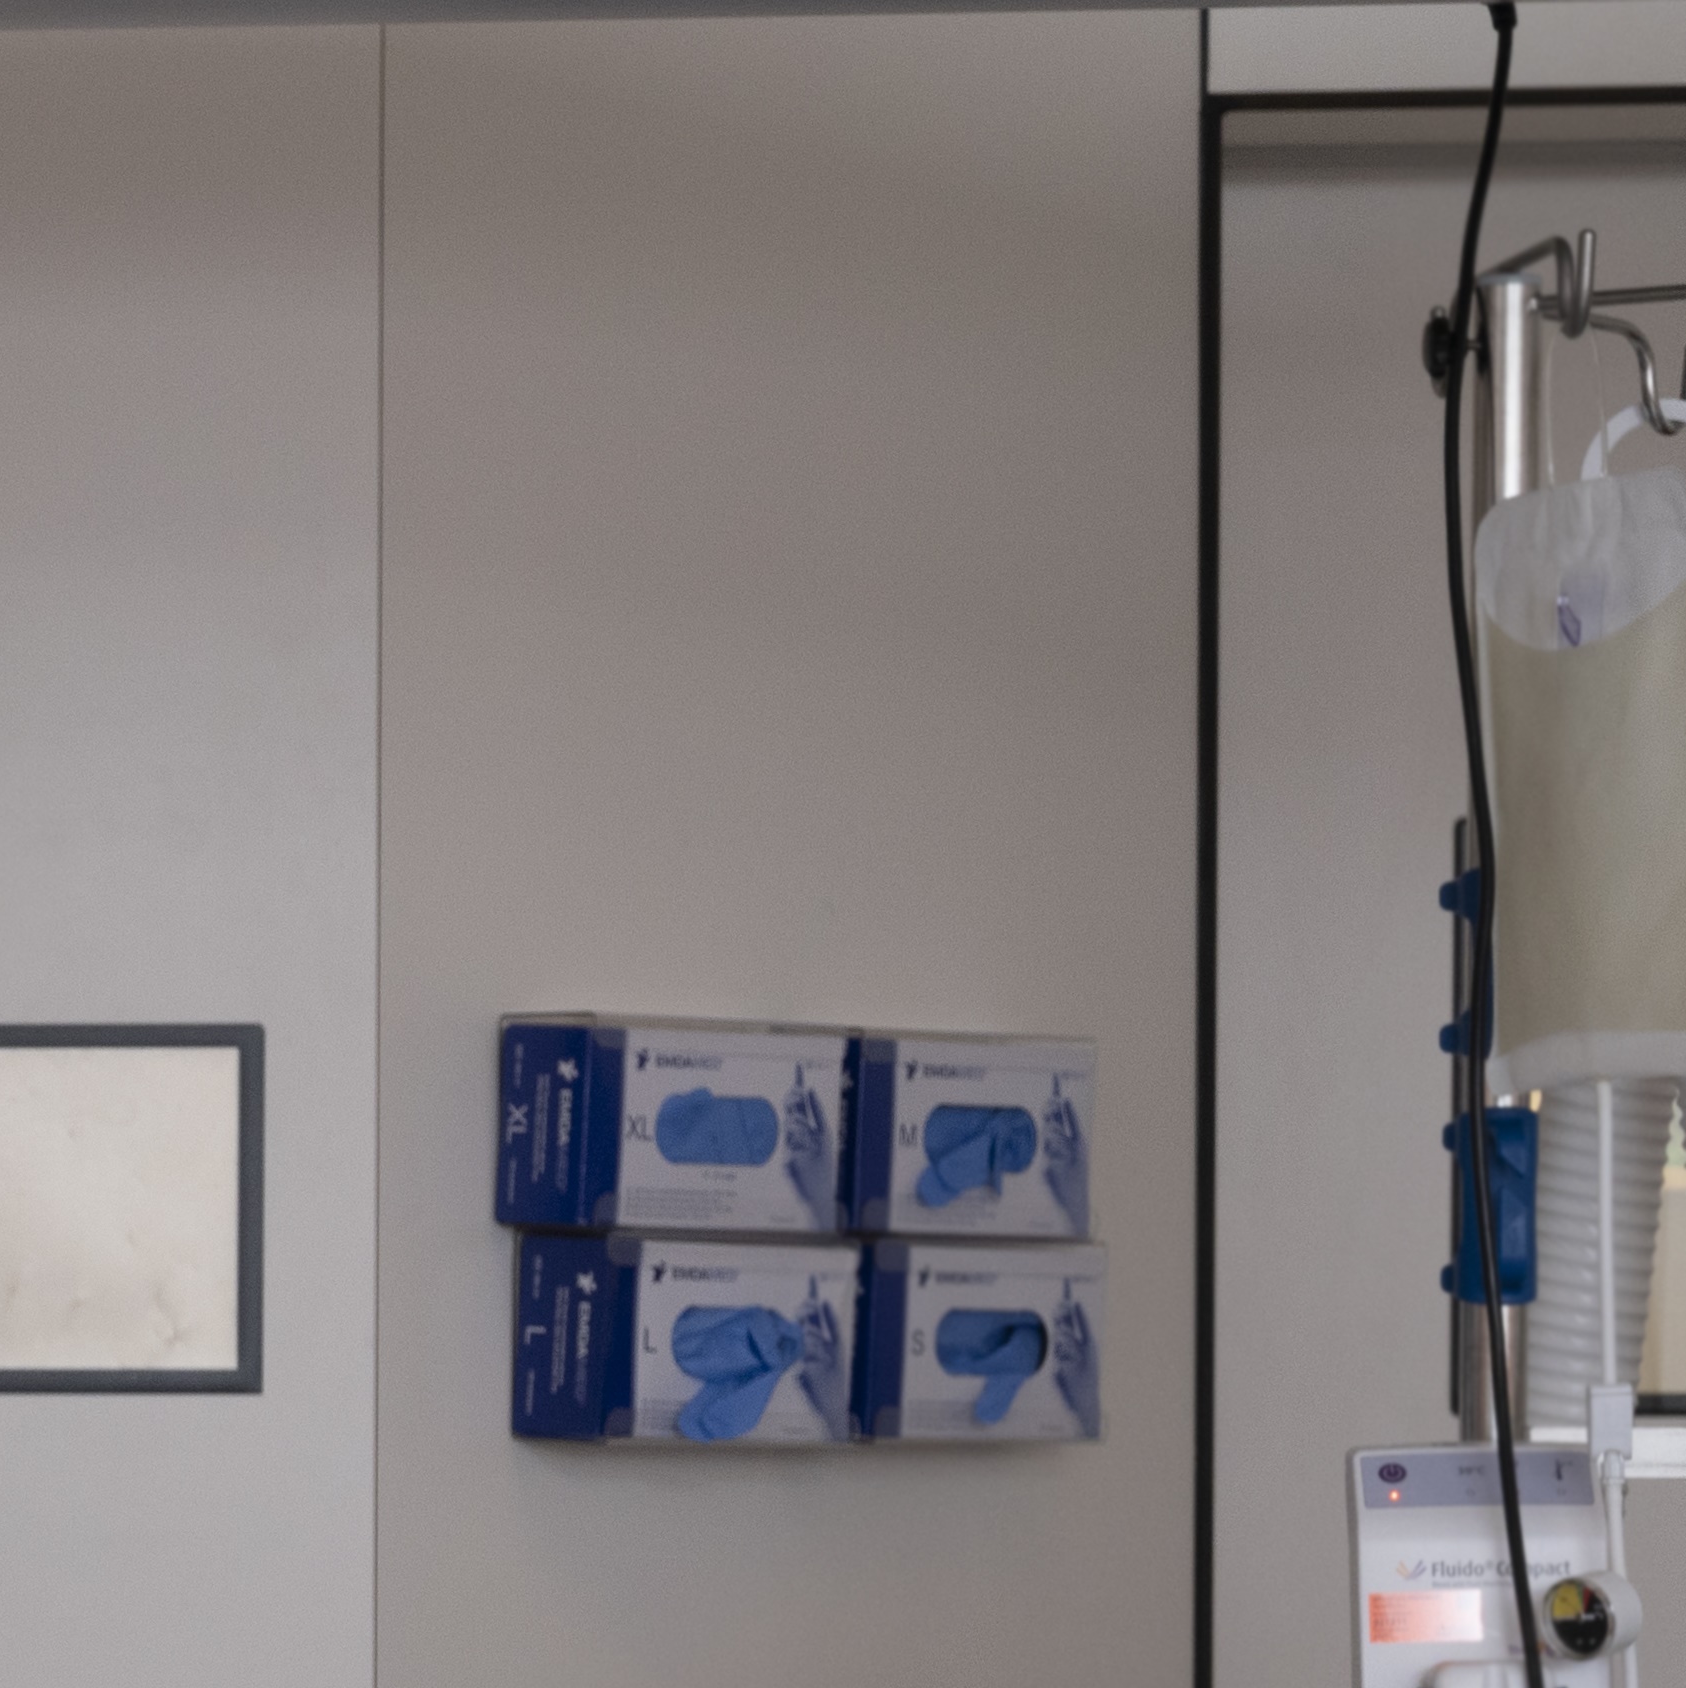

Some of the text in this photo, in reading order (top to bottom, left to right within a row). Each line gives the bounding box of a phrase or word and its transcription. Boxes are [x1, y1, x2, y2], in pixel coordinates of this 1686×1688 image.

[507, 1102, 528, 1144] XL
[627, 1114, 653, 1141] XL
[899, 1123, 917, 1146] M
[643, 1325, 657, 1354] L
[911, 1329, 925, 1356] S
[1496, 1560, 1571, 1579] Copact
